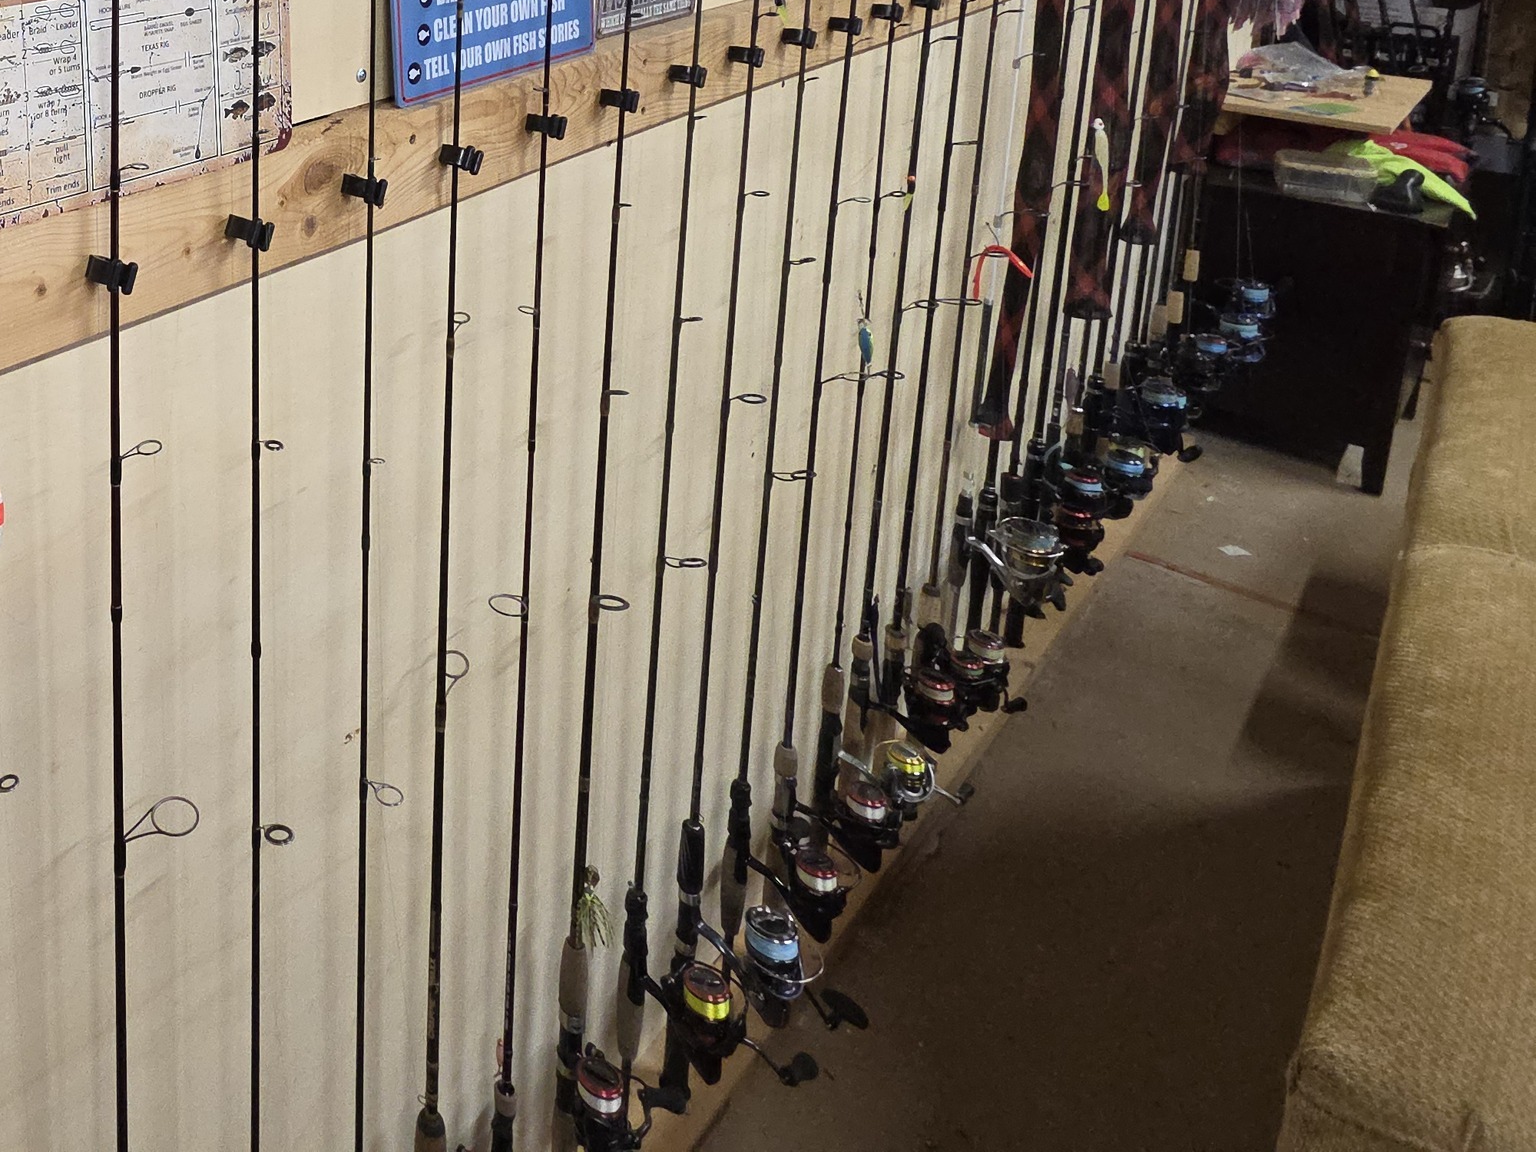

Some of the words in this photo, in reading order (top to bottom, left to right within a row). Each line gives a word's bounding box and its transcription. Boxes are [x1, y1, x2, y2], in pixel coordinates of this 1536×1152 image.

[475, 0, 508, 32] YOUR
[28, 26, 47, 36] Braid
[56, 20, 79, 31] Leader
[141, 43, 159, 52] TEXAS
[52, 56, 72, 65] Wrap
[423, 51, 450, 80] TELL
[485, 37, 511, 63] OWN
[513, 30, 536, 56] FISH
[64, 64, 81, 73] turns
